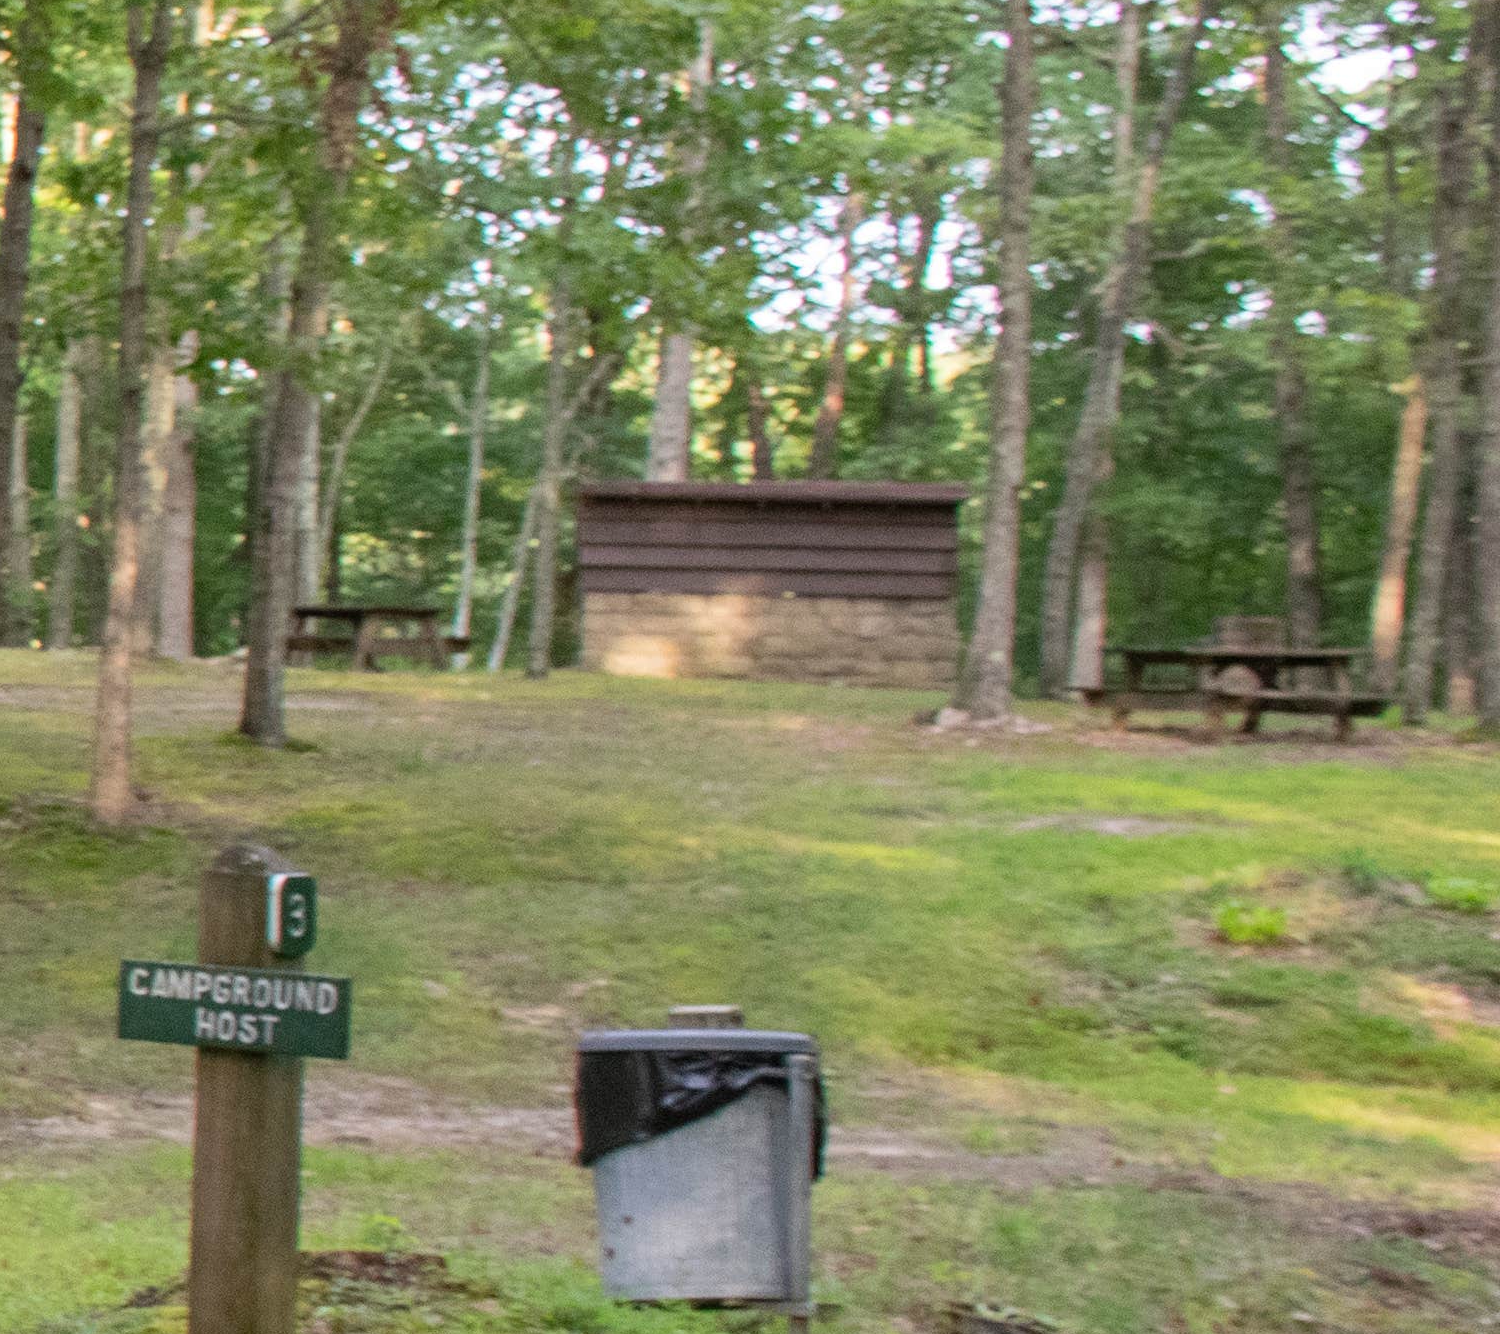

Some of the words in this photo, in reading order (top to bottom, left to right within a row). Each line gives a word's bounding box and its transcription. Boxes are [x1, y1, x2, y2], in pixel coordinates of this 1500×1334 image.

[286, 893, 307, 938] 3
[128, 967, 339, 1015] CAMPGROUND
[194, 1006, 282, 1045] HOST
